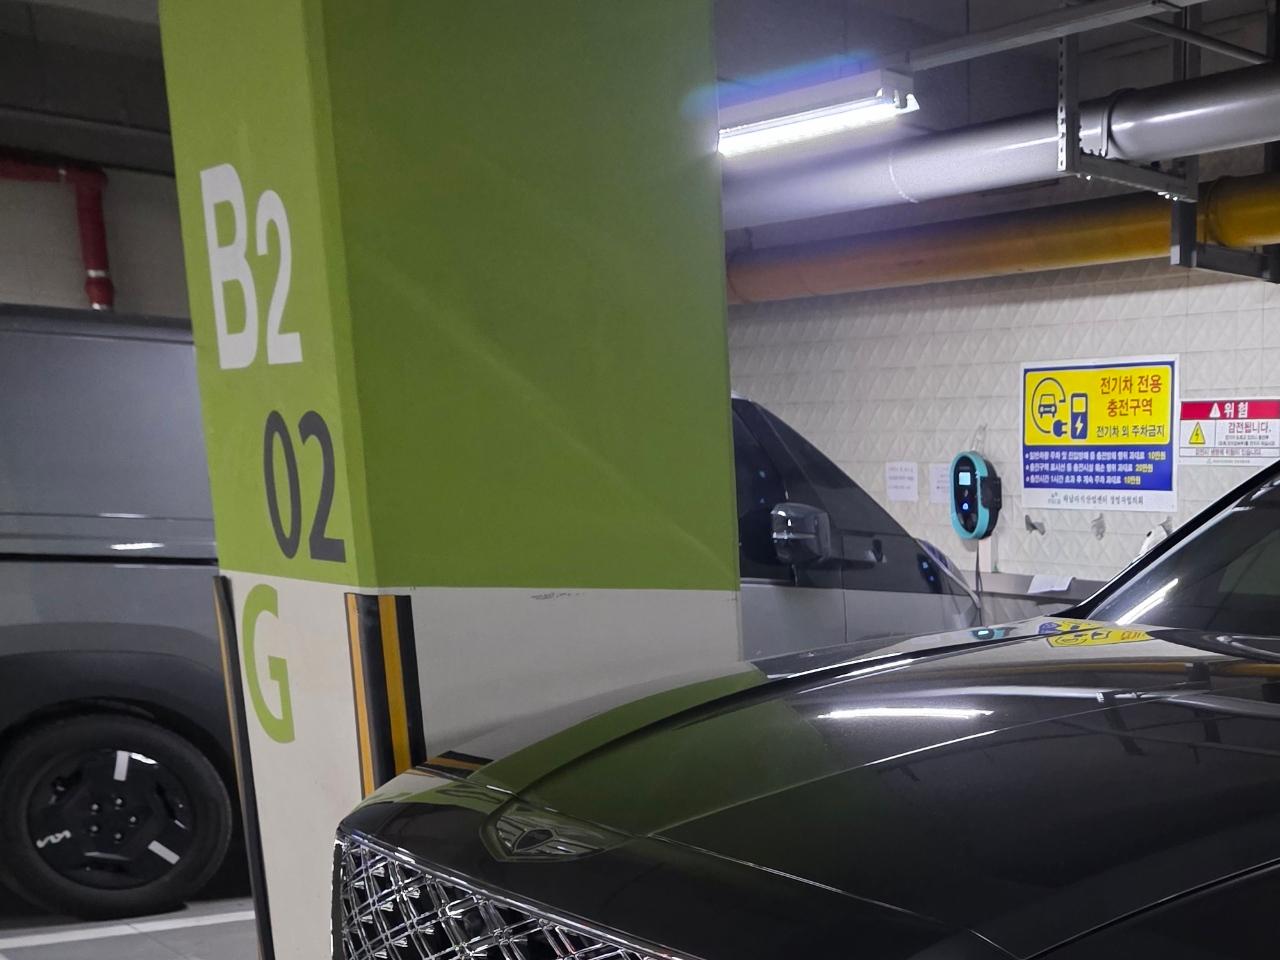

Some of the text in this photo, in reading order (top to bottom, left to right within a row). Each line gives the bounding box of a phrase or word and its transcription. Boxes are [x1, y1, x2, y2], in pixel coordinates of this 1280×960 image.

[200, 163, 303, 371] B2
[1100, 374, 1162, 395] 전기차 전용
[1107, 398, 1153, 417] 충전구역
[1096, 426, 1120, 438] 전기차
[1131, 424, 1165, 438] 주차금지
[263, 409, 347, 564] 02
[241, 584, 296, 744] G
